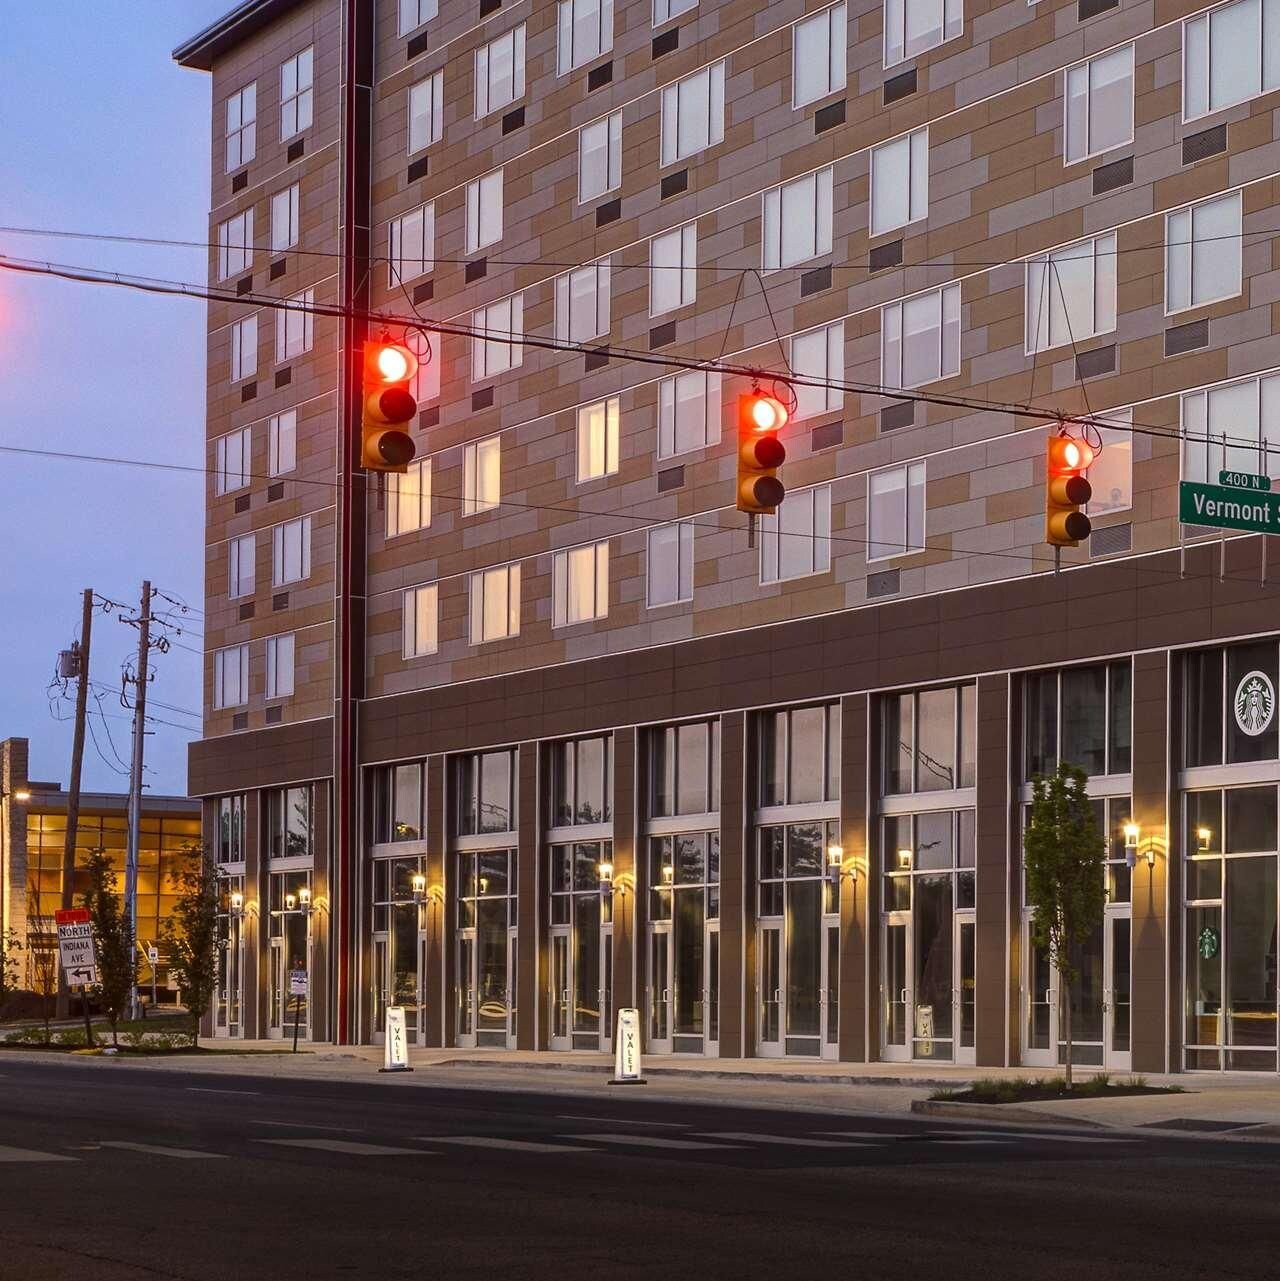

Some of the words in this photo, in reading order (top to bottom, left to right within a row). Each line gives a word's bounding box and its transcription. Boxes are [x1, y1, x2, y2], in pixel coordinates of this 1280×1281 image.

[1226, 472, 1248, 487] 400
[1252, 478, 1260, 489] N
[1193, 492, 1271, 524] Vermont
[60, 926, 90, 937] NORTH
[63, 941, 90, 951] INDIANA
[71, 954, 85, 963] AVE
[626, 1033, 634, 1073] VALET
